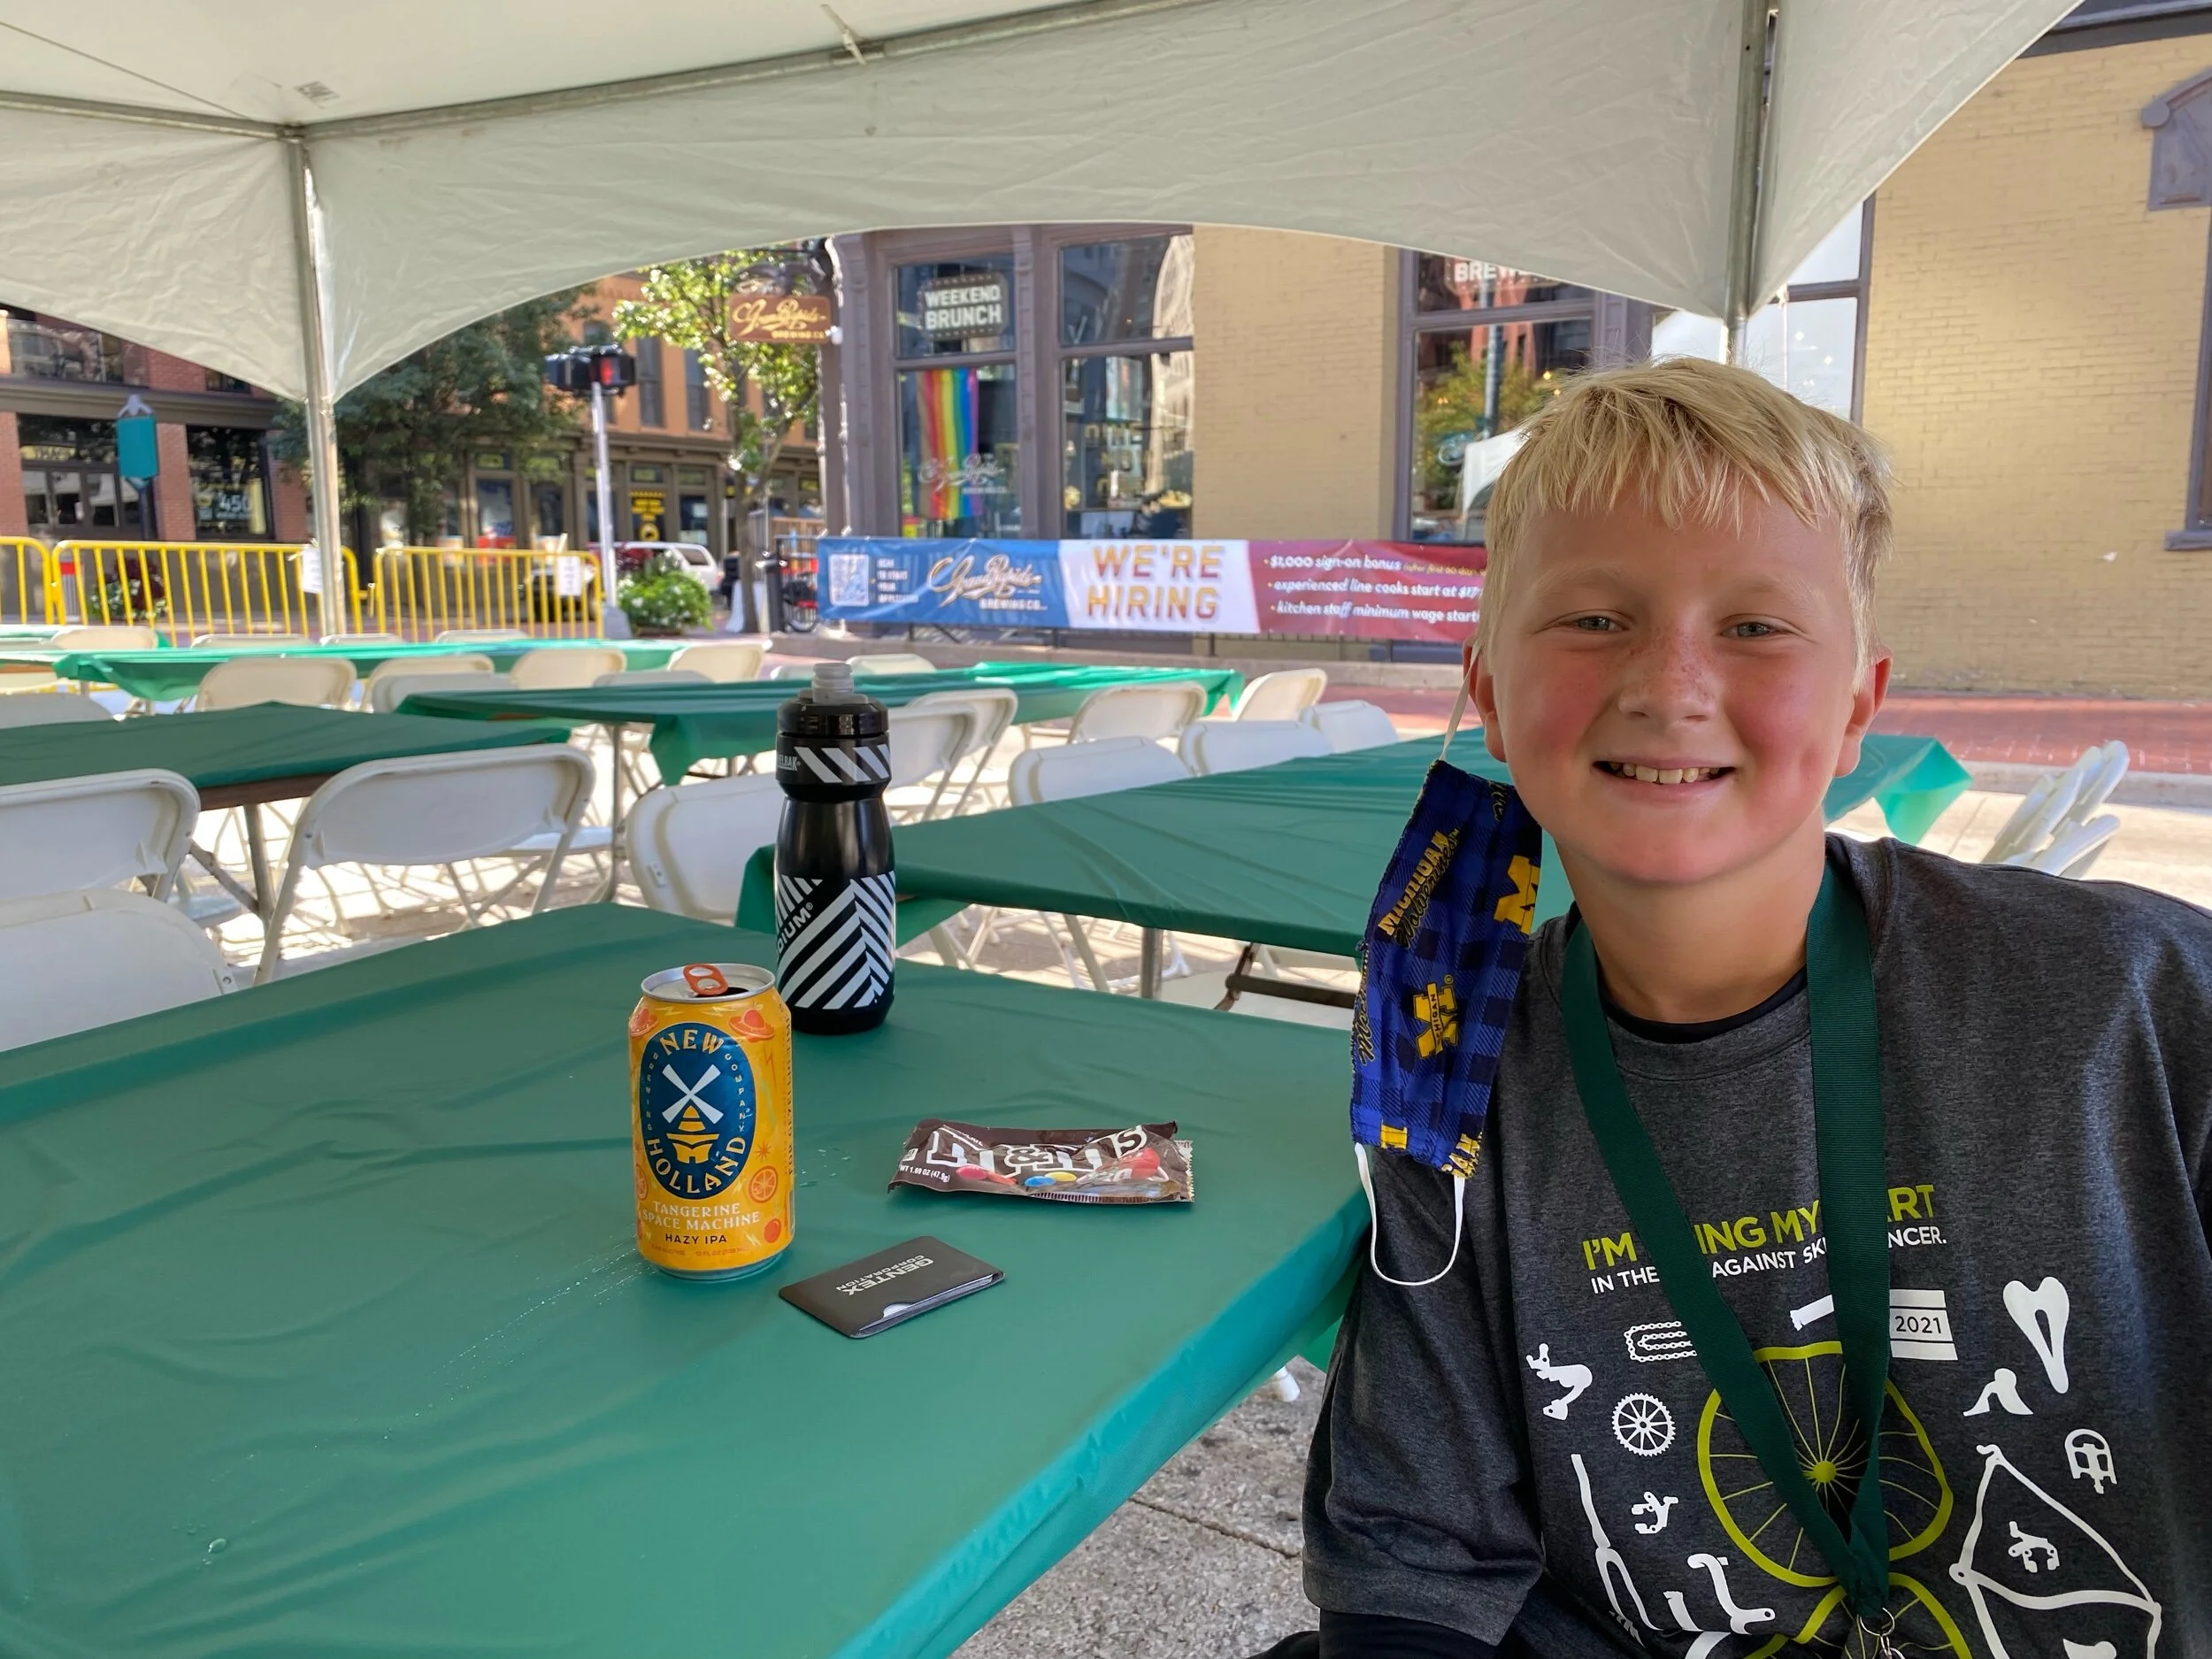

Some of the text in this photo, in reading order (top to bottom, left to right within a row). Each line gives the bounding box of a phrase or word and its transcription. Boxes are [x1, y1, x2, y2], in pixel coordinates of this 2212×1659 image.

[925, 285, 1001, 308] WEEKEND
[926, 304, 1002, 330] BRUNCH
[1093, 545, 1224, 579] WE'RE
[1363, 554, 1402, 571] bonus
[1087, 585, 1218, 619] HIRING
[1274, 578, 1348, 594] experienced
[1349, 578, 1373, 594] line
[1375, 580, 1409, 595] cooks
[1411, 584, 1440, 596] start
[1441, 586, 1456, 597] at
[1277, 600, 1322, 615] kitchen
[1323, 602, 1353, 618] staff
[1353, 603, 1409, 618] minimum
[1412, 610, 1445, 624] wage
[1378, 830, 1449, 936] MICHIGAN
[777, 907, 811, 954] DIUM
[659, 1029, 724, 1056] NEW
[645, 1052, 659, 1131] BREWING
[724, 1053, 747, 1133] COMPANY
[647, 1136, 746, 1194] HOLLAND
[910, 1165, 922, 1174] 1.69
[642, 1209, 760, 1231] SPACE MACHINE
[653, 1201, 741, 1218] TANGERINE
[665, 1233, 727, 1245] HAZY IPA
[1583, 1184, 1934, 1271] I'M ING MY RT
[835, 1255, 925, 1291] CORPORATION
[1591, 1225, 1947, 1294] IN THE AGAINST SKI NCER.
[841, 1257, 934, 1296] GENTEX
[1894, 1315, 1942, 1334] 2021
